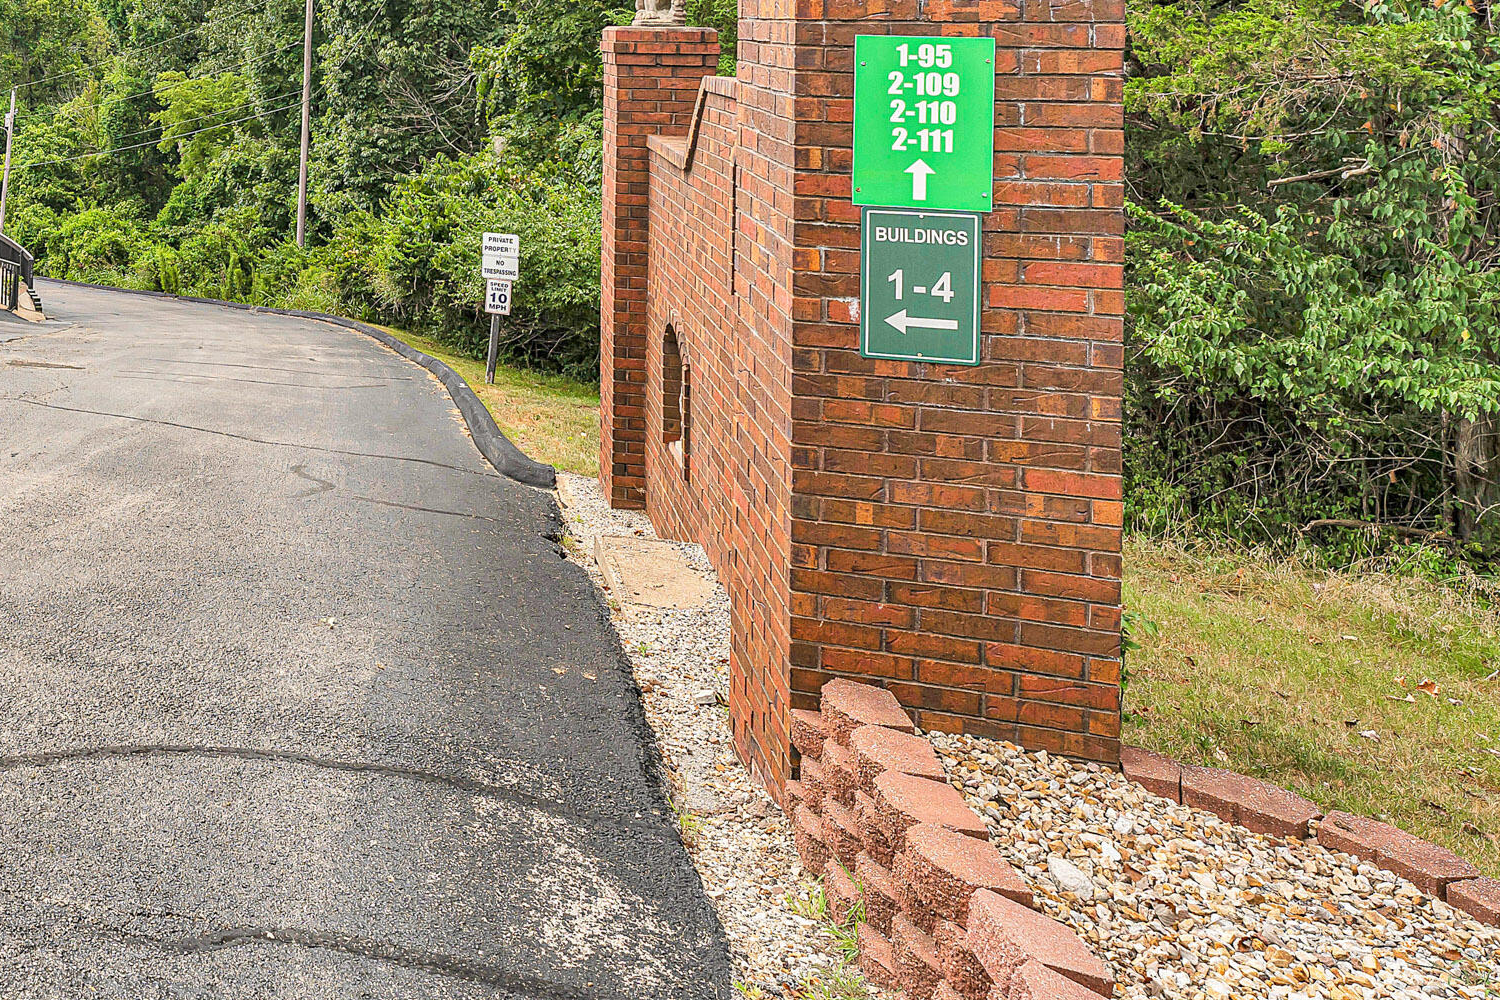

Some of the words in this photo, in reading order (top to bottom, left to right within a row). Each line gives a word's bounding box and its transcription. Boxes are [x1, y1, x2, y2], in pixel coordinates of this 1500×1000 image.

[896, 43, 952, 68] 1-95
[887, 71, 960, 97] 2-109
[889, 99, 957, 125] 2-110
[891, 127, 954, 153] 2-111
[488, 236, 513, 244] PRIVATE
[875, 227, 968, 246] BUILDINGS
[484, 245, 517, 253] PROPERTY
[484, 267, 517, 276] TRESPASSING
[490, 292, 508, 304] 10
[488, 303, 507, 311] MPH
